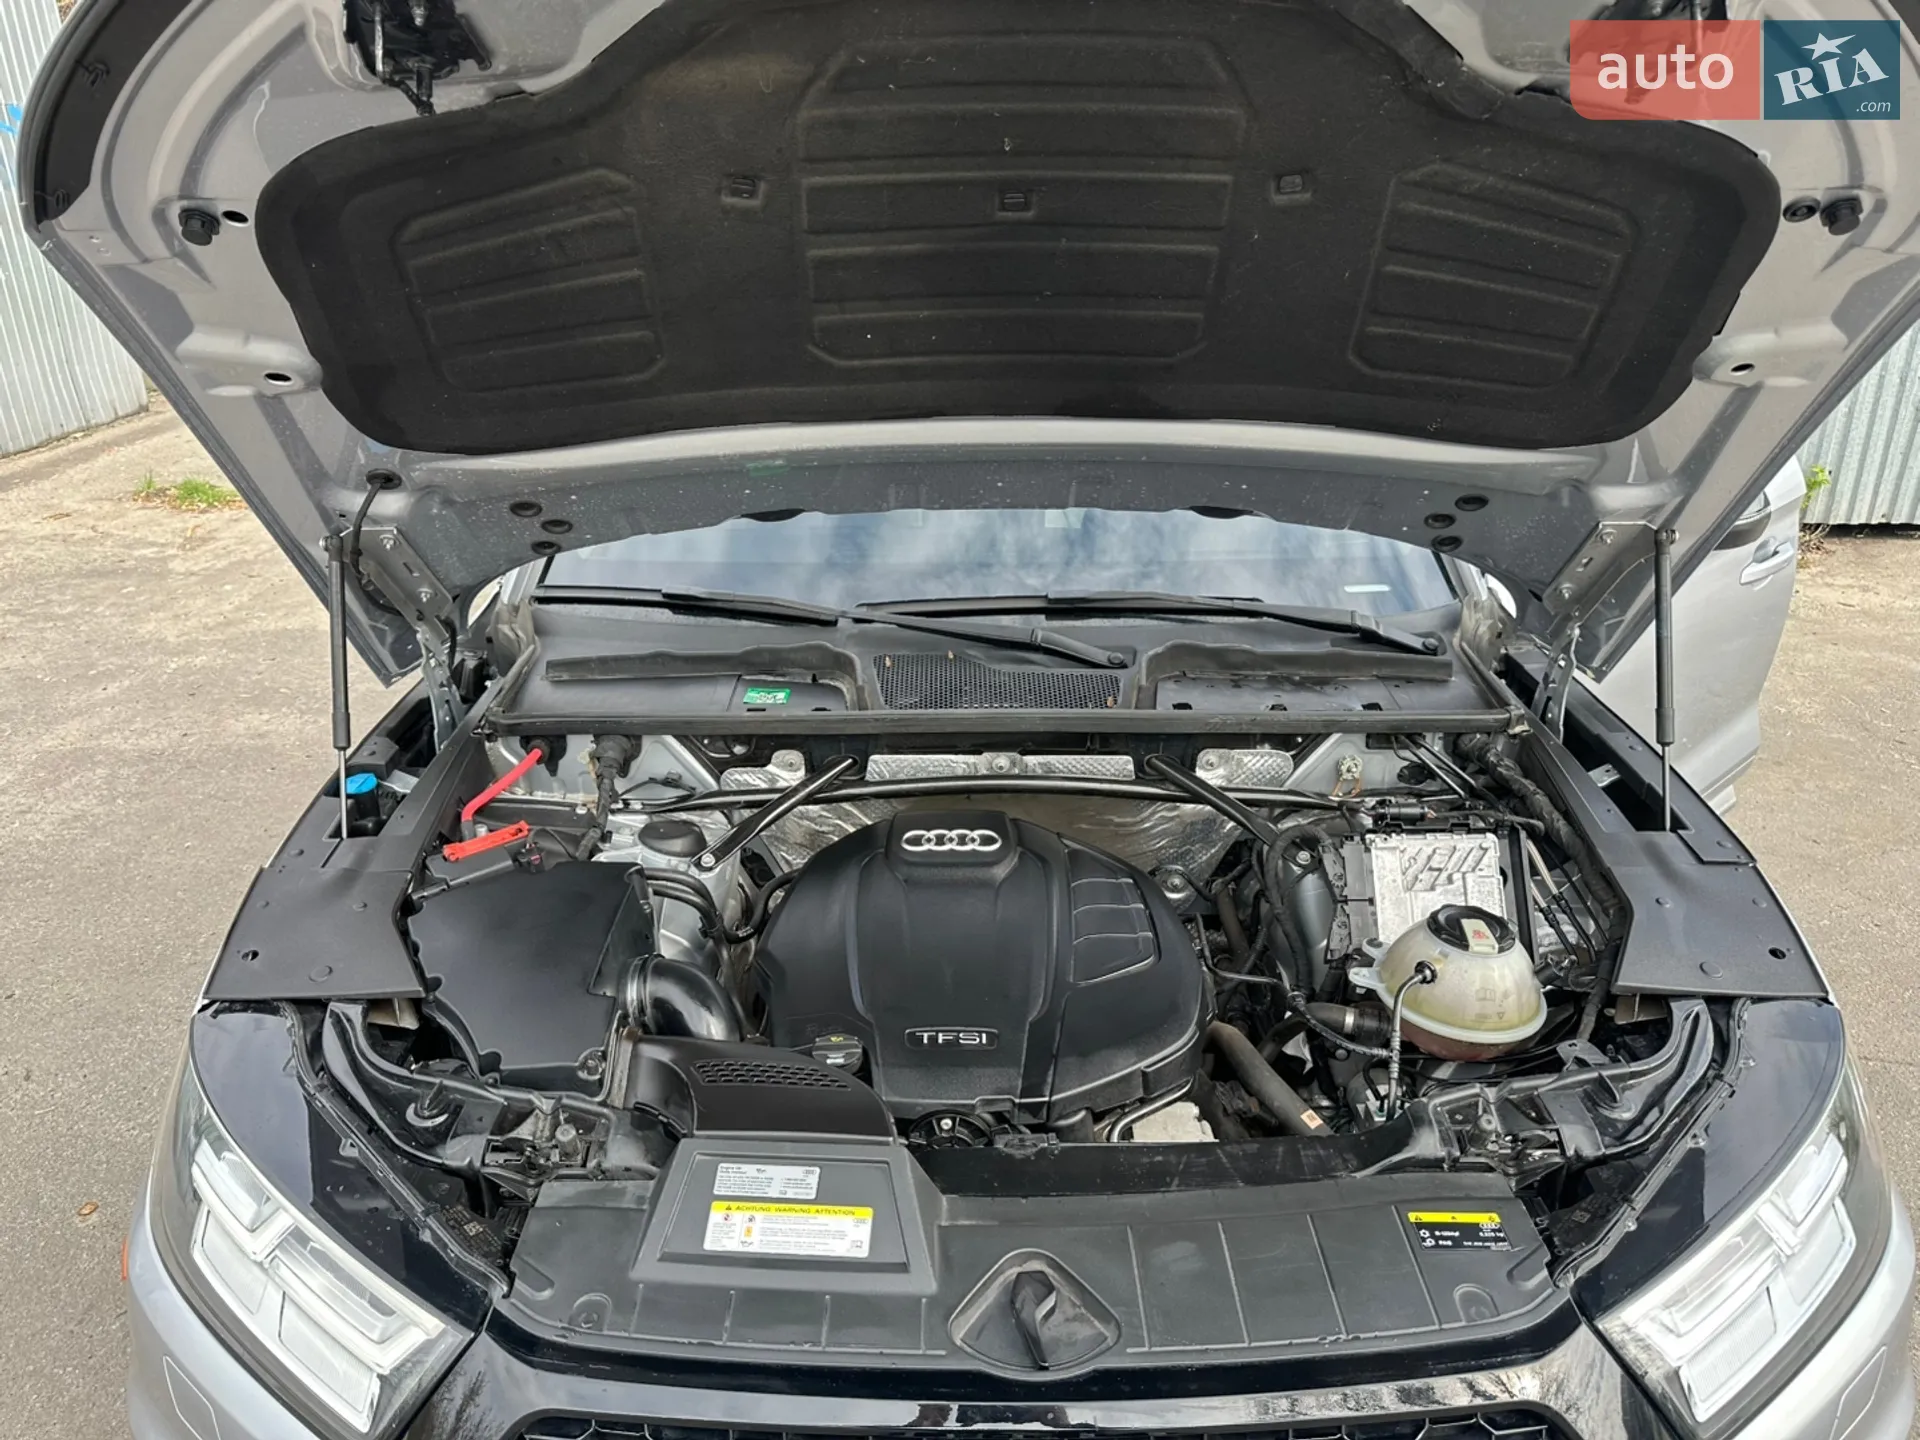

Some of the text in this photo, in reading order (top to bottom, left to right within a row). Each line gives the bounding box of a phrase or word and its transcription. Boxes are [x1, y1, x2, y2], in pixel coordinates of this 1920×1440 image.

[915, 1032, 987, 1044] TFSI
[735, 1205, 771, 1213] ACHTUNG
[815, 1208, 856, 1216] ATTENTION
